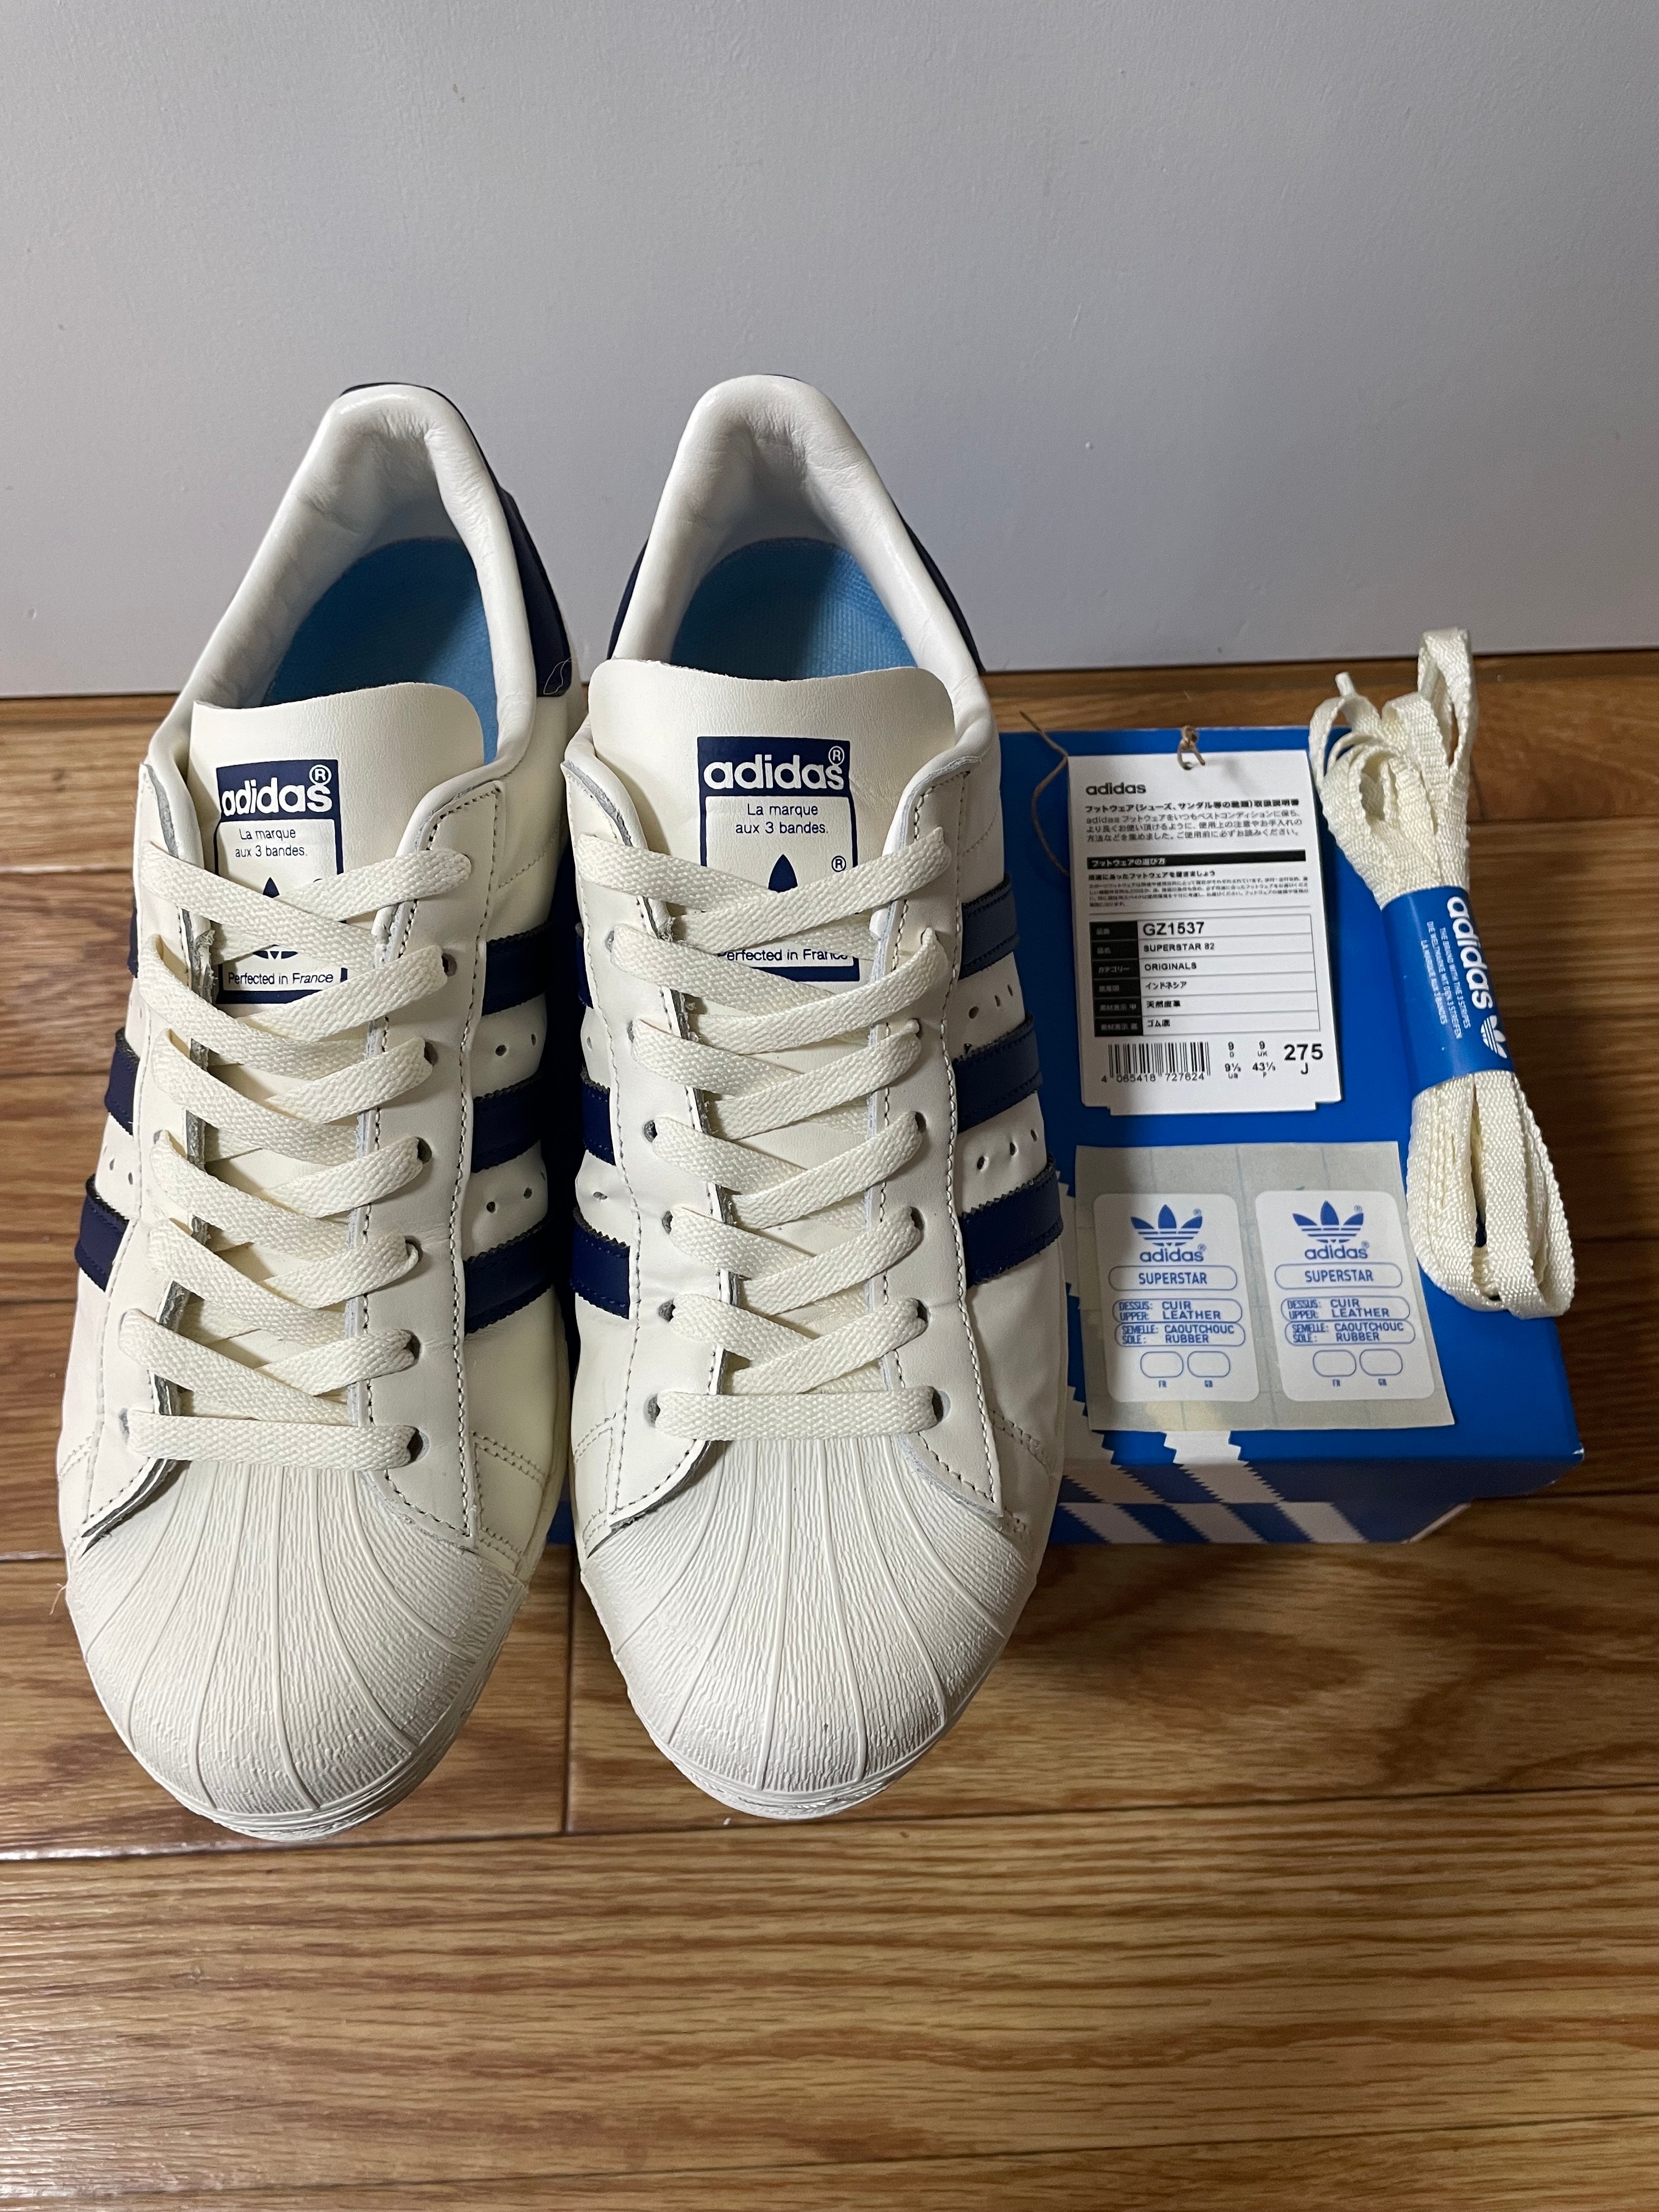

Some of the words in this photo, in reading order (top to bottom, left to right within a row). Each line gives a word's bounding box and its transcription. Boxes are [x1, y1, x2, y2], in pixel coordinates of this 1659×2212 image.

[704, 754, 844, 790] adidas
[1085, 782, 1146, 795] adidas
[221, 777, 333, 816] adidas
[748, 803, 764, 816] La
[769, 804, 819, 817] marque
[736, 824, 759, 834] aux
[765, 822, 774, 834] 3
[780, 821, 828, 834] bandes.
[239, 828, 253, 840] La
[256, 828, 296, 842] marque
[235, 847, 252, 858] aux
[255, 845, 262, 857] 3
[266, 845, 308, 857] bandes.
[1142, 922, 1205, 936] GZ1537
[1143, 943, 1201, 952] SUPERSTAR
[1447, 896, 1493, 1009] adidas
[717, 949, 782, 961] erfected
[787, 949, 798, 960] in
[1144, 962, 1197, 971] ORIGINALS
[228, 973, 275, 985] Perfected
[279, 973, 288, 985] in
[292, 973, 334, 985] France
[1145, 981, 1187, 990] インドネシア
[1284, 1043, 1323, 1061] 275
[1300, 1062, 1308, 1075] J
[1101, 1075, 1107, 1083] 4
[1165, 1073, 1204, 1082] 727624
[1139, 1248, 1204, 1262] adidas
[1304, 1245, 1368, 1260] adidas
[1138, 1272, 1207, 1285] SUPERSTAR
[1305, 1269, 1374, 1283] SUPERSTAR
[1162, 1301, 1191, 1311] CUIR
[1330, 1298, 1360, 1308] CUIR
[1162, 1310, 1221, 1320] LEATHER
[1331, 1308, 1390, 1318] LEATHER
[1164, 1324, 1234, 1334] CAOUTCHOUC
[1334, 1322, 1404, 1332] CAOUTCHOUC
[1165, 1334, 1209, 1344] RUBBER
[1335, 1332, 1380, 1342] RUBBER
